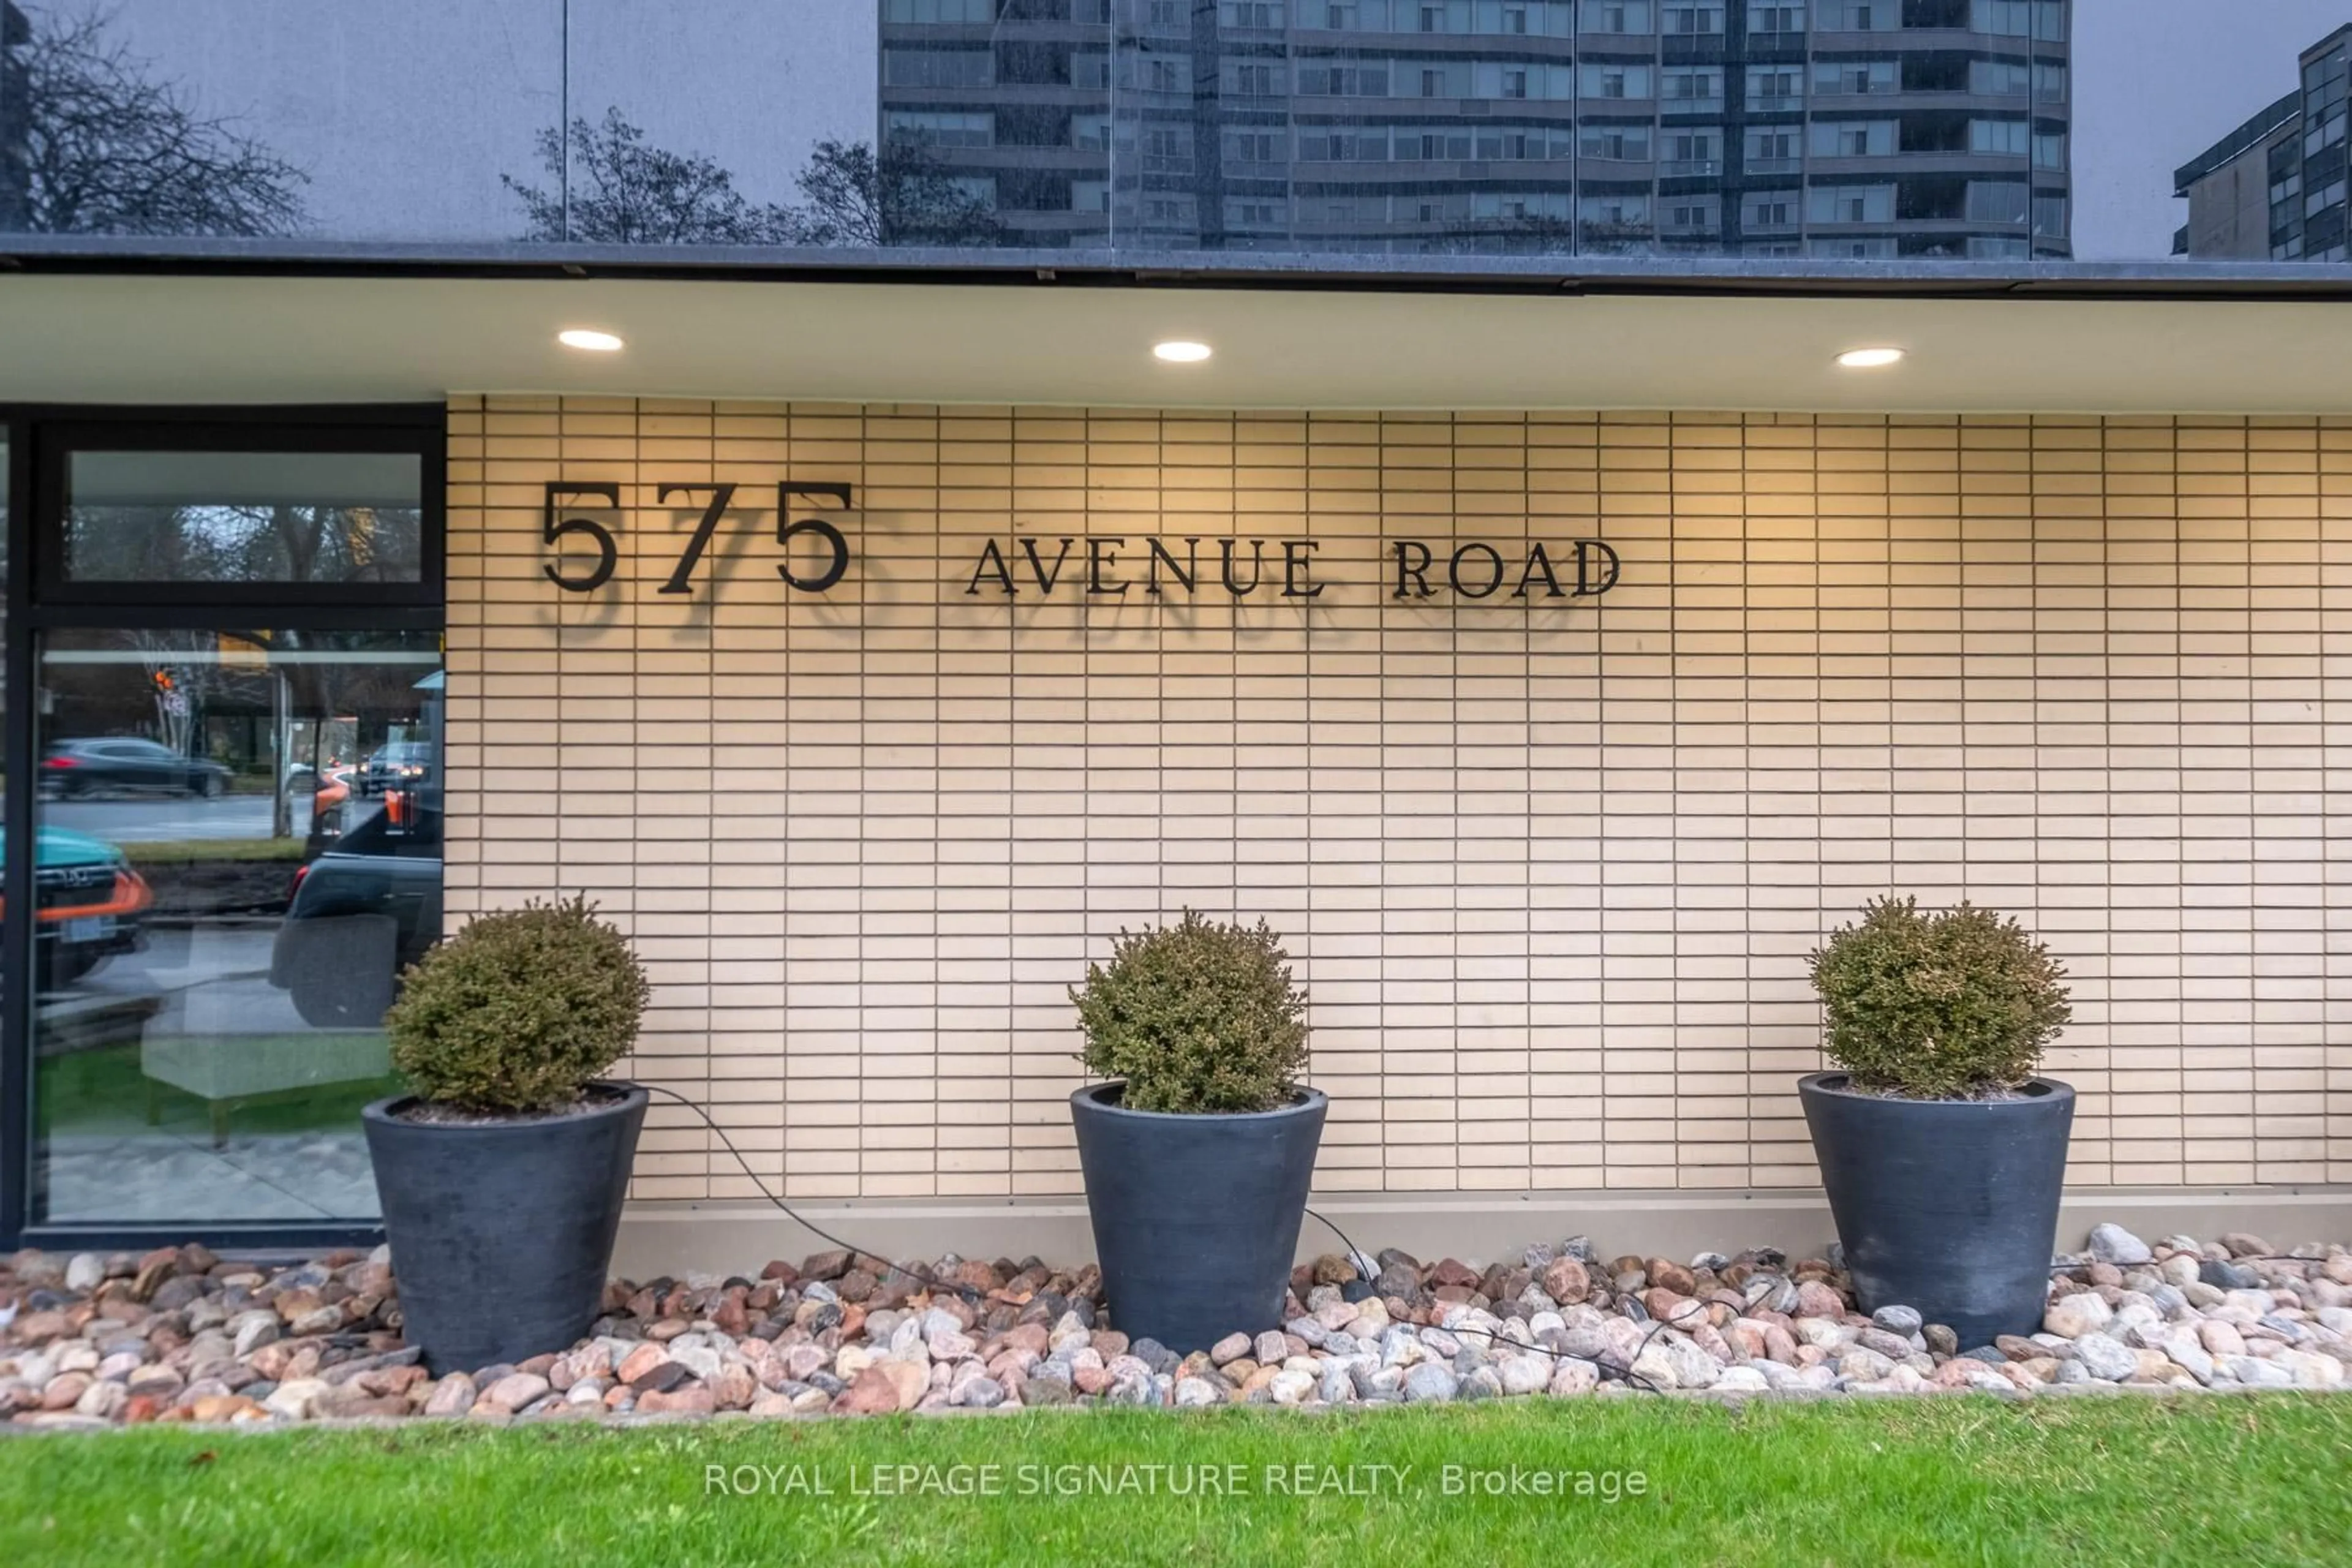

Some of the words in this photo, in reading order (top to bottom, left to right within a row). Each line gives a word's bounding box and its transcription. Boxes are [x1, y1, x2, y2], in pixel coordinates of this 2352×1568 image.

[544, 481, 851, 592] 575
[965, 538, 1325, 597] AVENUE
[1392, 541, 1620, 598] ROAD
